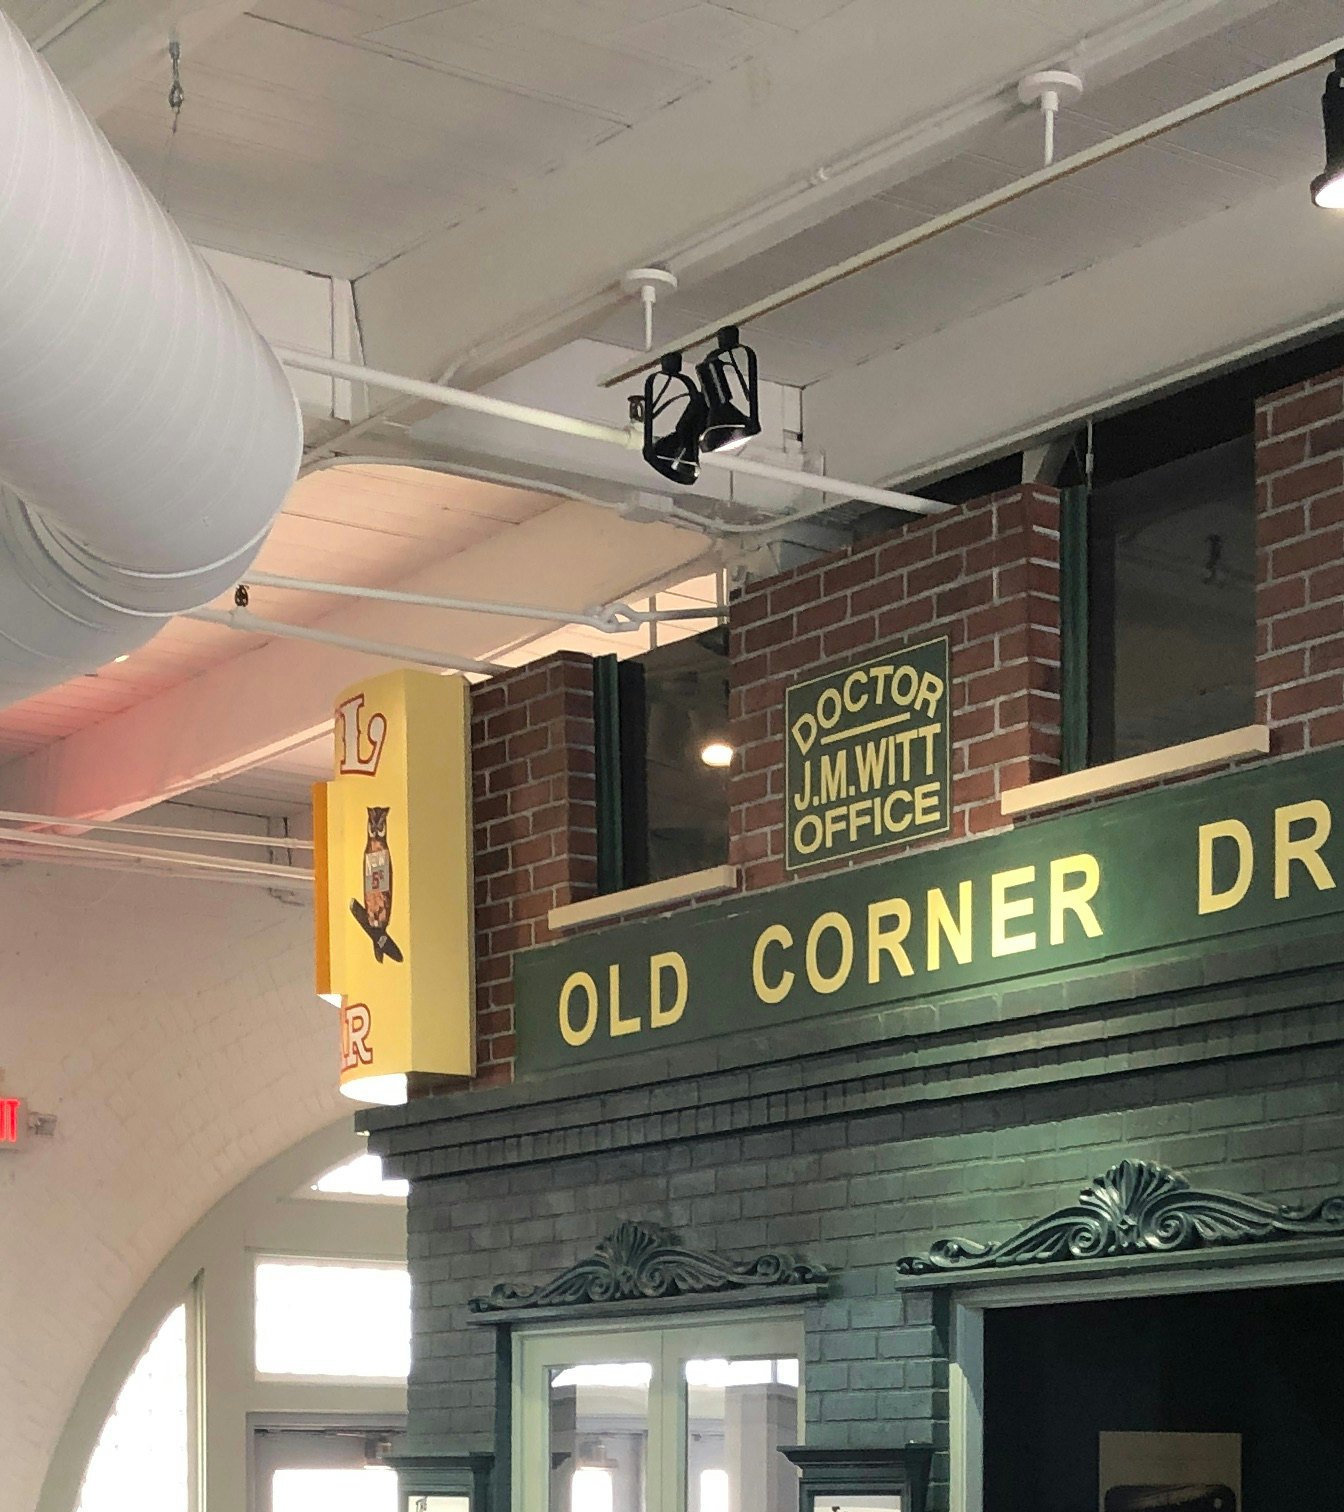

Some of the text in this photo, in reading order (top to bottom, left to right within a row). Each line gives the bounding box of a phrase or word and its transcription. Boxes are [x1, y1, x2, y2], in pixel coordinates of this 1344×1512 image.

[792, 665, 944, 755] DOCTOR
[794, 782, 940, 854] OFFICE
[559, 951, 688, 1046] OLD
[753, 853, 1104, 1003] CORNER
